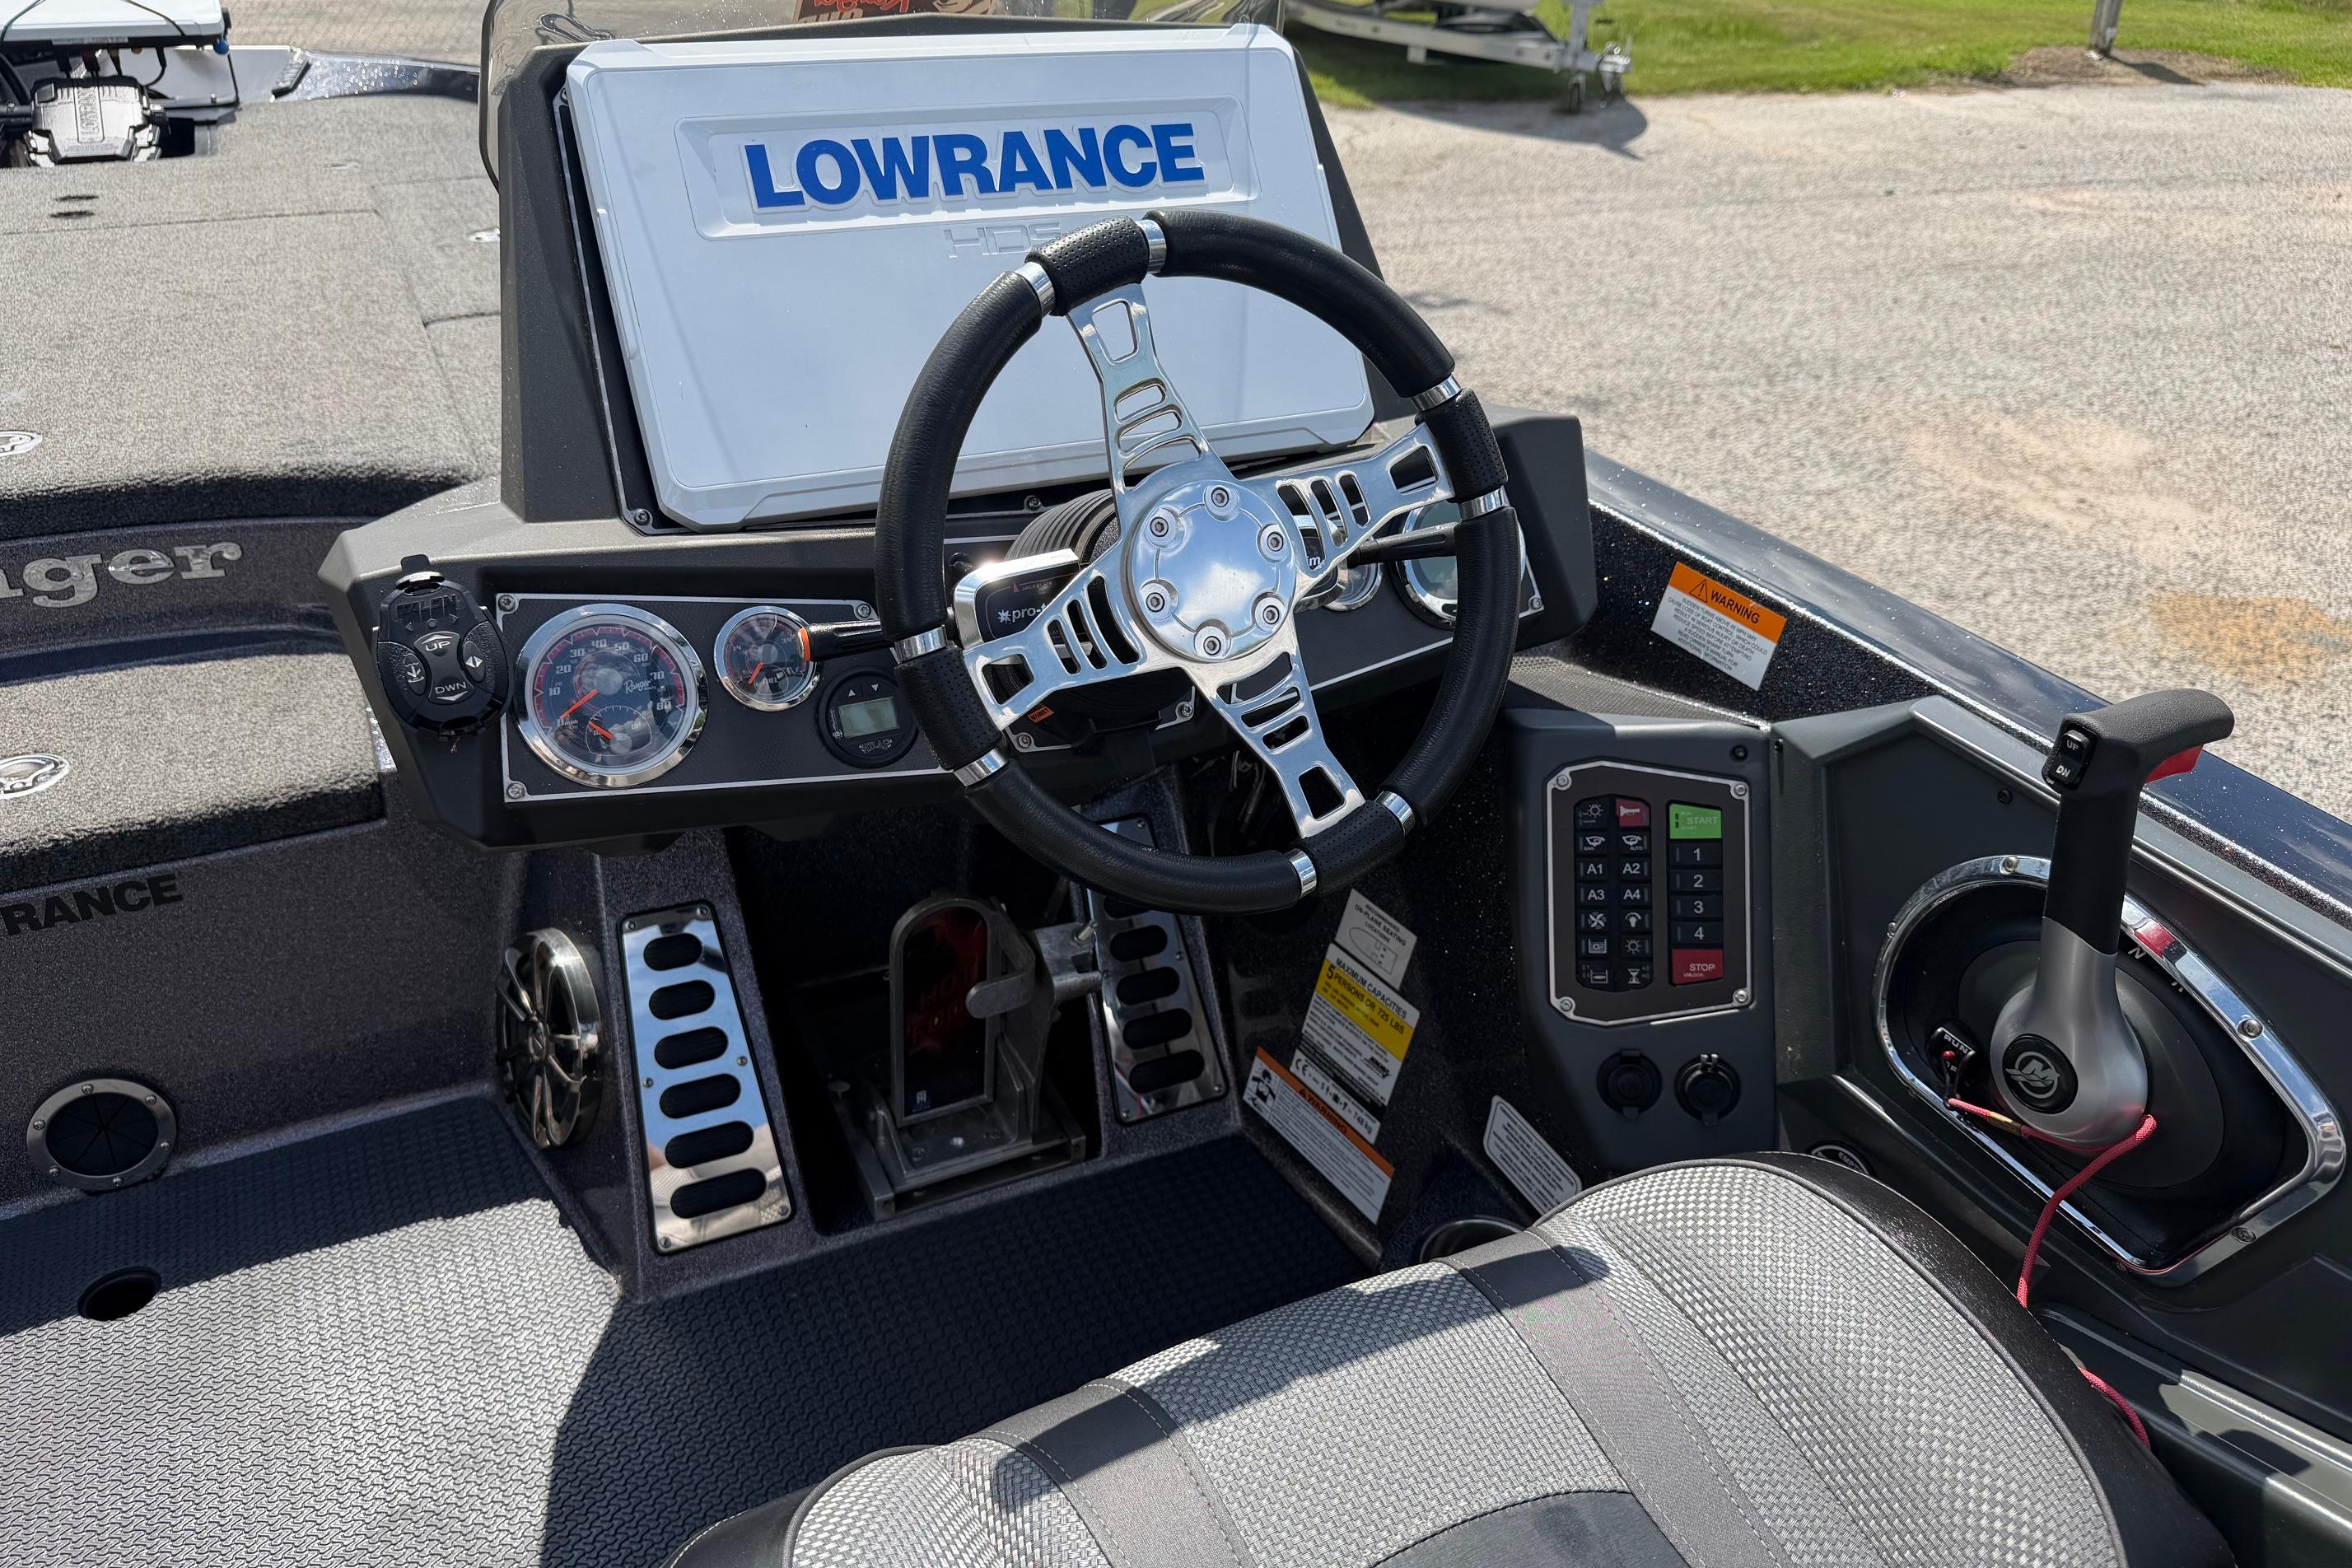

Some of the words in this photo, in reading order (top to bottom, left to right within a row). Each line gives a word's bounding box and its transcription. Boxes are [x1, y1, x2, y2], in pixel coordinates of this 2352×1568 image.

[744, 123, 1205, 208] LOWRANCE
[1710, 589, 1760, 623] WARNING
[426, 641, 450, 651] UP
[591, 639, 607, 649] 40
[614, 642, 630, 651] 50
[570, 648, 586, 658] 30
[633, 653, 649, 663] 60
[556, 665, 572, 674] 20
[650, 670, 665, 681] 70
[435, 682, 467, 694] DWN
[548, 687, 561, 696] 10
[624, 679, 653, 694] Ranger
[656, 700, 672, 711] 80
[2066, 740, 2079, 750] UP
[2056, 765, 2070, 777] DN
[1693, 848, 1701, 861] 1
[1587, 863, 1603, 875] A1
[1622, 863, 1640, 875] A2
[1693, 875, 1704, 888] 2
[1587, 889, 1605, 901] A3
[1623, 889, 1641, 901] A4
[1693, 900, 1704, 914] 3
[1383, 925, 1405, 945] SEATING
[1694, 926, 1705, 940] 4
[1689, 963, 1715, 972] STOP
[1336, 958, 1366, 987] MAXIMUM
[1367, 982, 1407, 1019] CAPACITIES
[1327, 964, 1335, 979] 5
[1333, 973, 1365, 1002] PERSONS
[1365, 998, 1375, 1010] OR
[1377, 1008, 1388, 1021] 725
[1389, 1018, 1403, 1034] LBS
[1944, 1034, 1968, 1054] RUN
[1308, 1094, 1346, 1135] WARNING
